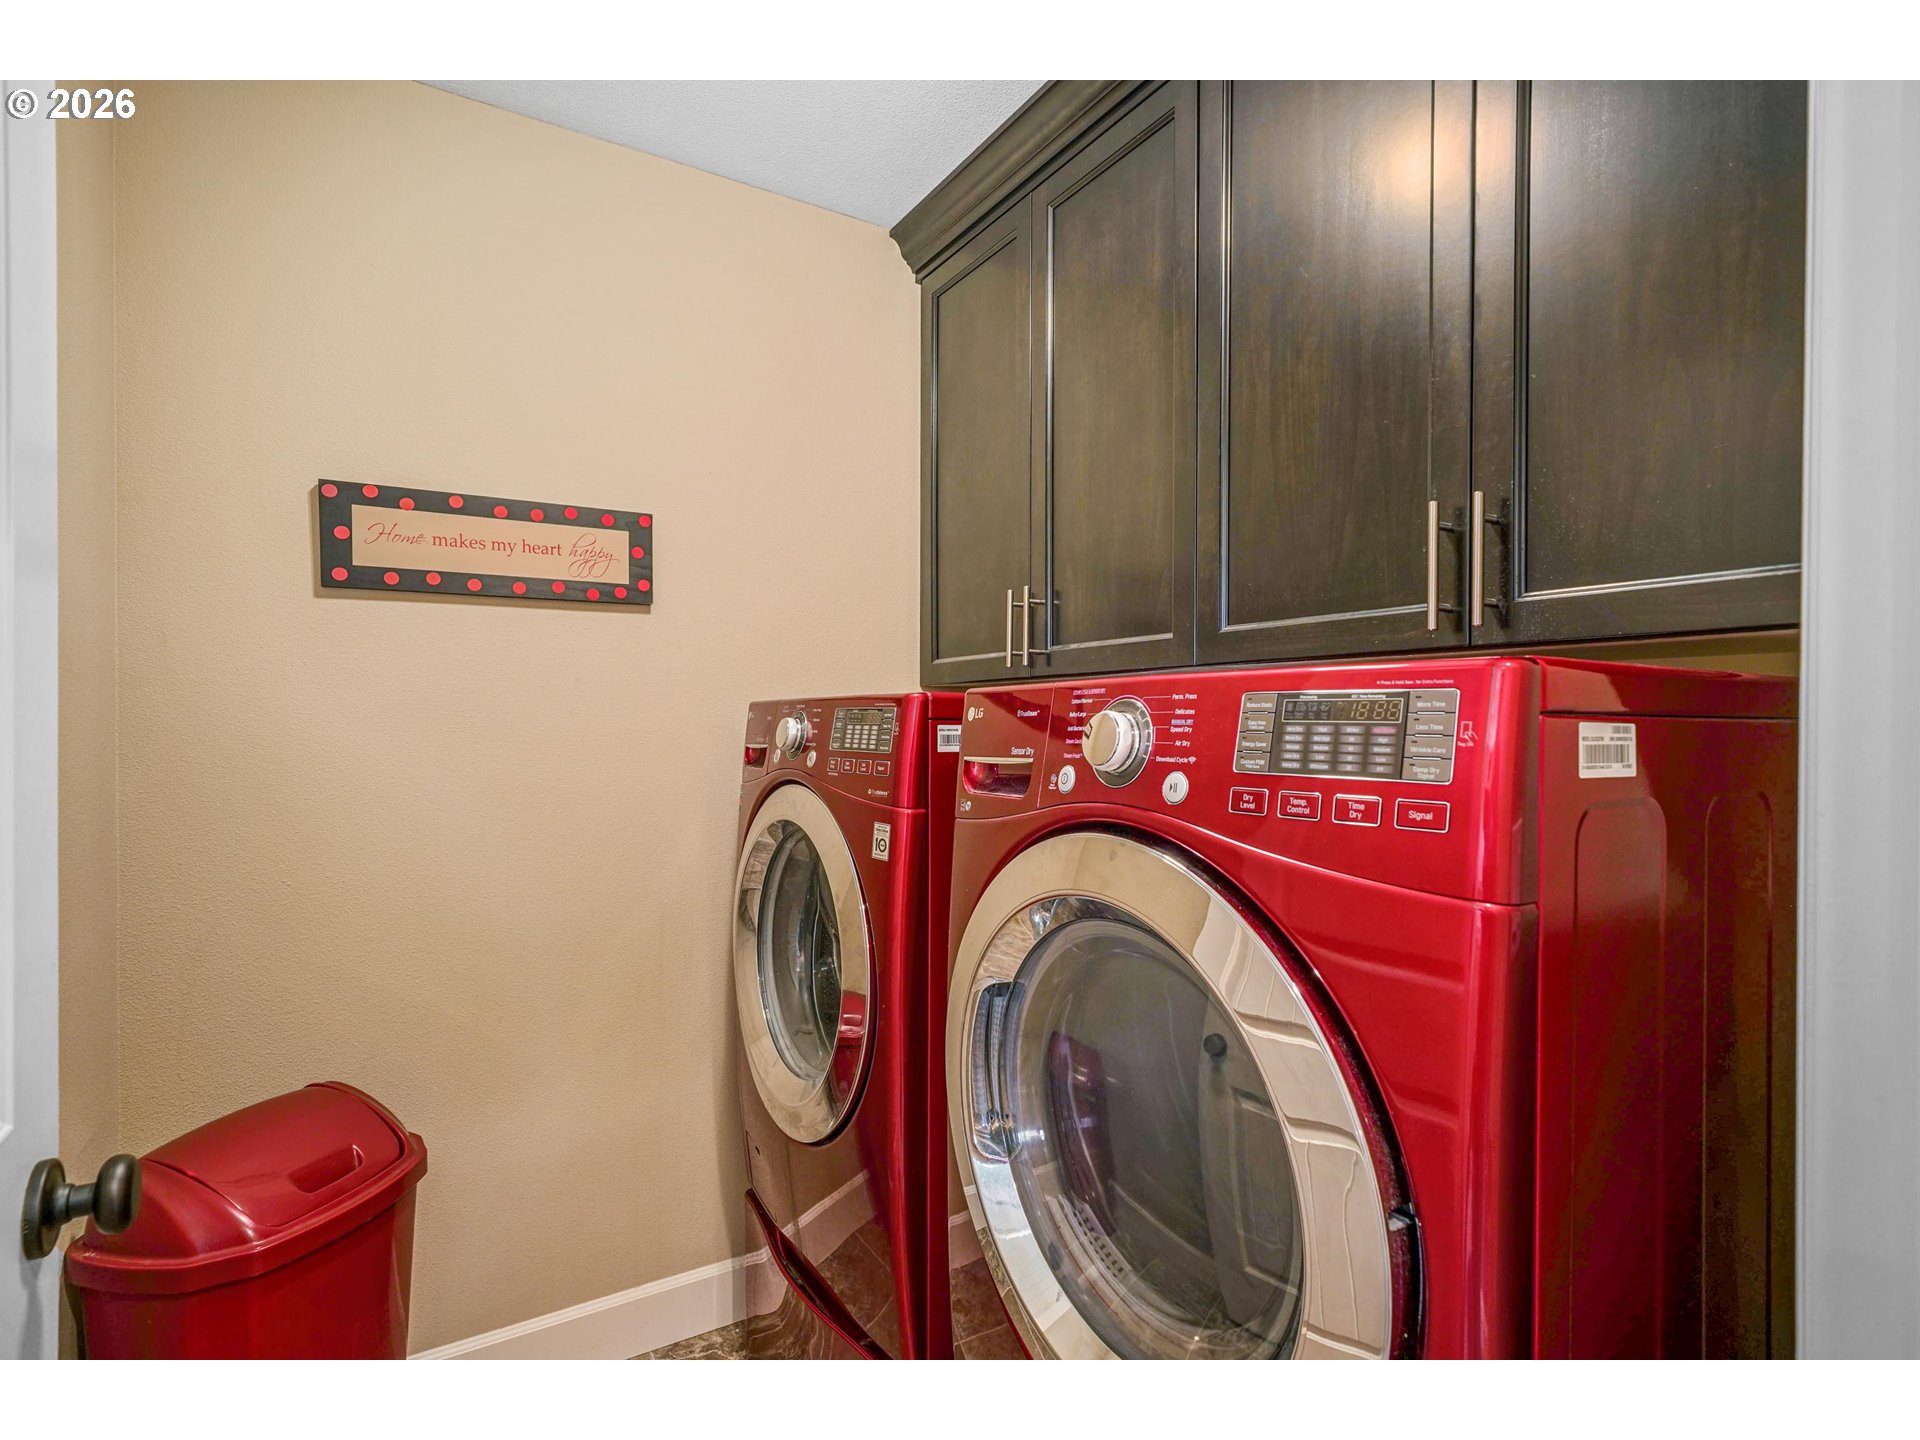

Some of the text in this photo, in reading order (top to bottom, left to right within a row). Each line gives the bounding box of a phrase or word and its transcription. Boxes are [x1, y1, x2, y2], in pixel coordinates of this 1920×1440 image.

[364, 522, 620, 578] Home makes my heart happy
[1011, 747, 1034, 757] Sensor Dry
[1243, 793, 1253, 802] Dry
[1289, 797, 1308, 806] Temp.
[1287, 805, 1310, 814] Control
[1347, 801, 1365, 811] Time
[1349, 810, 1363, 820] Dry
[1408, 810, 1433, 820] Signal
[875, 837, 887, 853] 10
